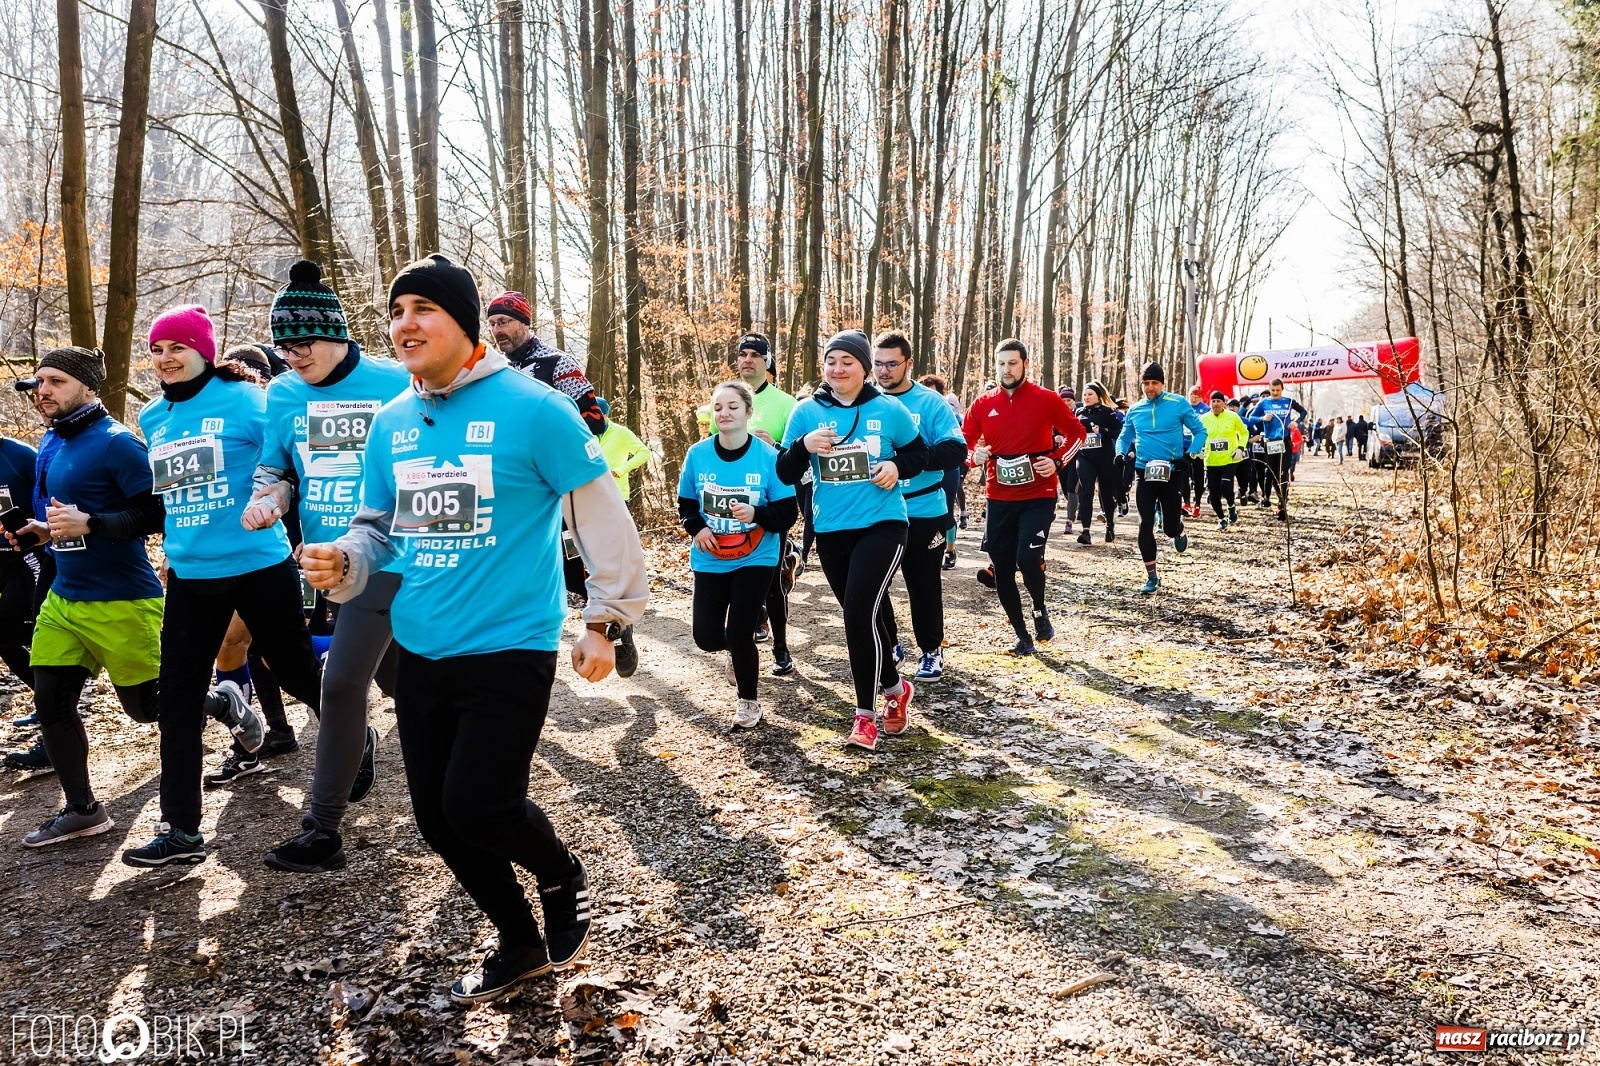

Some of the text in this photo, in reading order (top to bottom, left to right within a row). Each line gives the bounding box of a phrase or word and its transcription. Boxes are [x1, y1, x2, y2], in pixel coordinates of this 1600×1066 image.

[1294, 350, 1319, 358] BIEG
[1274, 358, 1339, 370] TWARDZIELA
[1281, 368, 1333, 379] RACIBÓRZ
[204, 420, 221, 431] TBI
[294, 416, 308, 428] DL
[321, 417, 366, 438] 038
[868, 420, 880, 430] TBI
[392, 427, 420, 446] DLO
[470, 424, 490, 439] TBI
[174, 438, 207, 448] Twardziela
[165, 453, 200, 478] 134
[828, 456, 856, 472] 021
[427, 470, 468, 479] Twardziela
[1002, 466, 1025, 478] 083
[1150, 466, 1165, 476] 071
[698, 473, 717, 482] DLO
[748, 475, 760, 484] TBI
[165, 498, 235, 515] WARDZIELA
[304, 502, 359, 514] TWARDZI
[412, 490, 460, 517] 005
[176, 514, 210, 528] 2022
[415, 552, 460, 568] 2022
